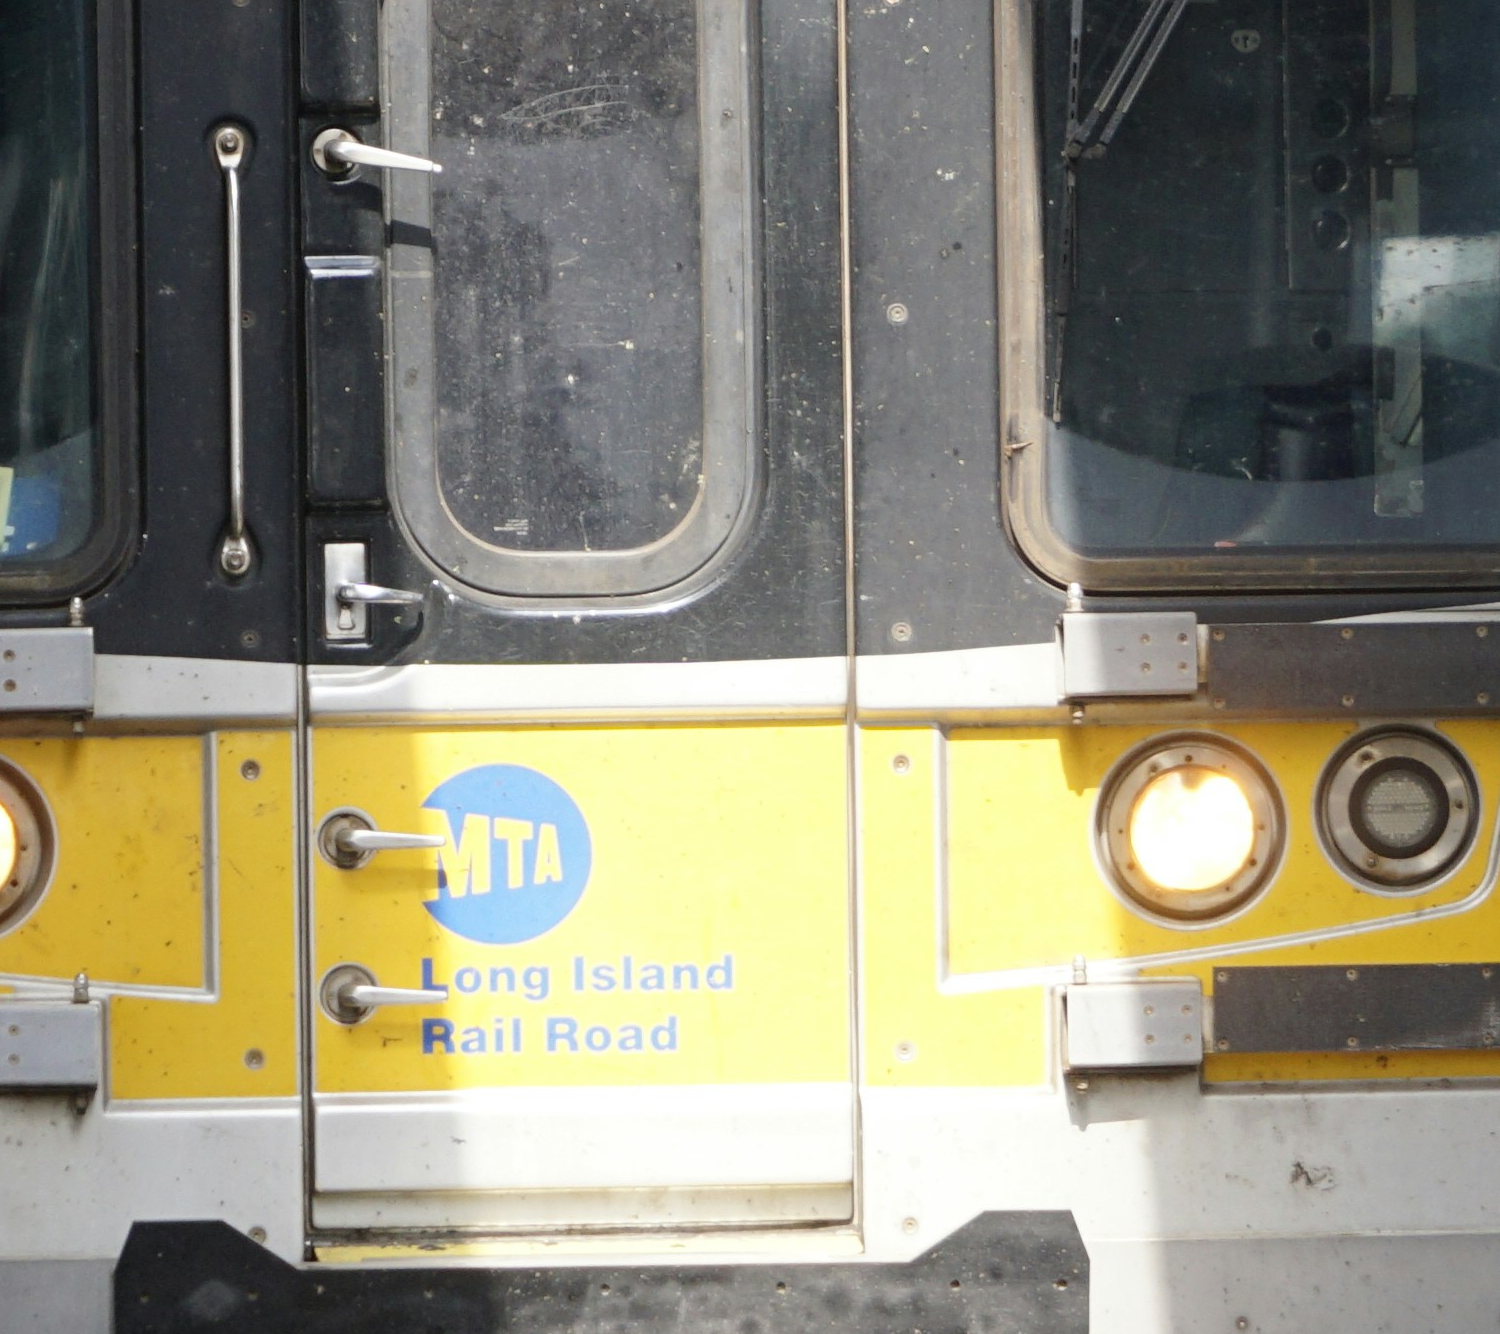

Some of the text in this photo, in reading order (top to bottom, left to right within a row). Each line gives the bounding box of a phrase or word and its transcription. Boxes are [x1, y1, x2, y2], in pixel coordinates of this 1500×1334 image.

[419, 805, 564, 899] MTA
[420, 953, 735, 1002] Long Island
[420, 1015, 679, 1055] Rail Road
